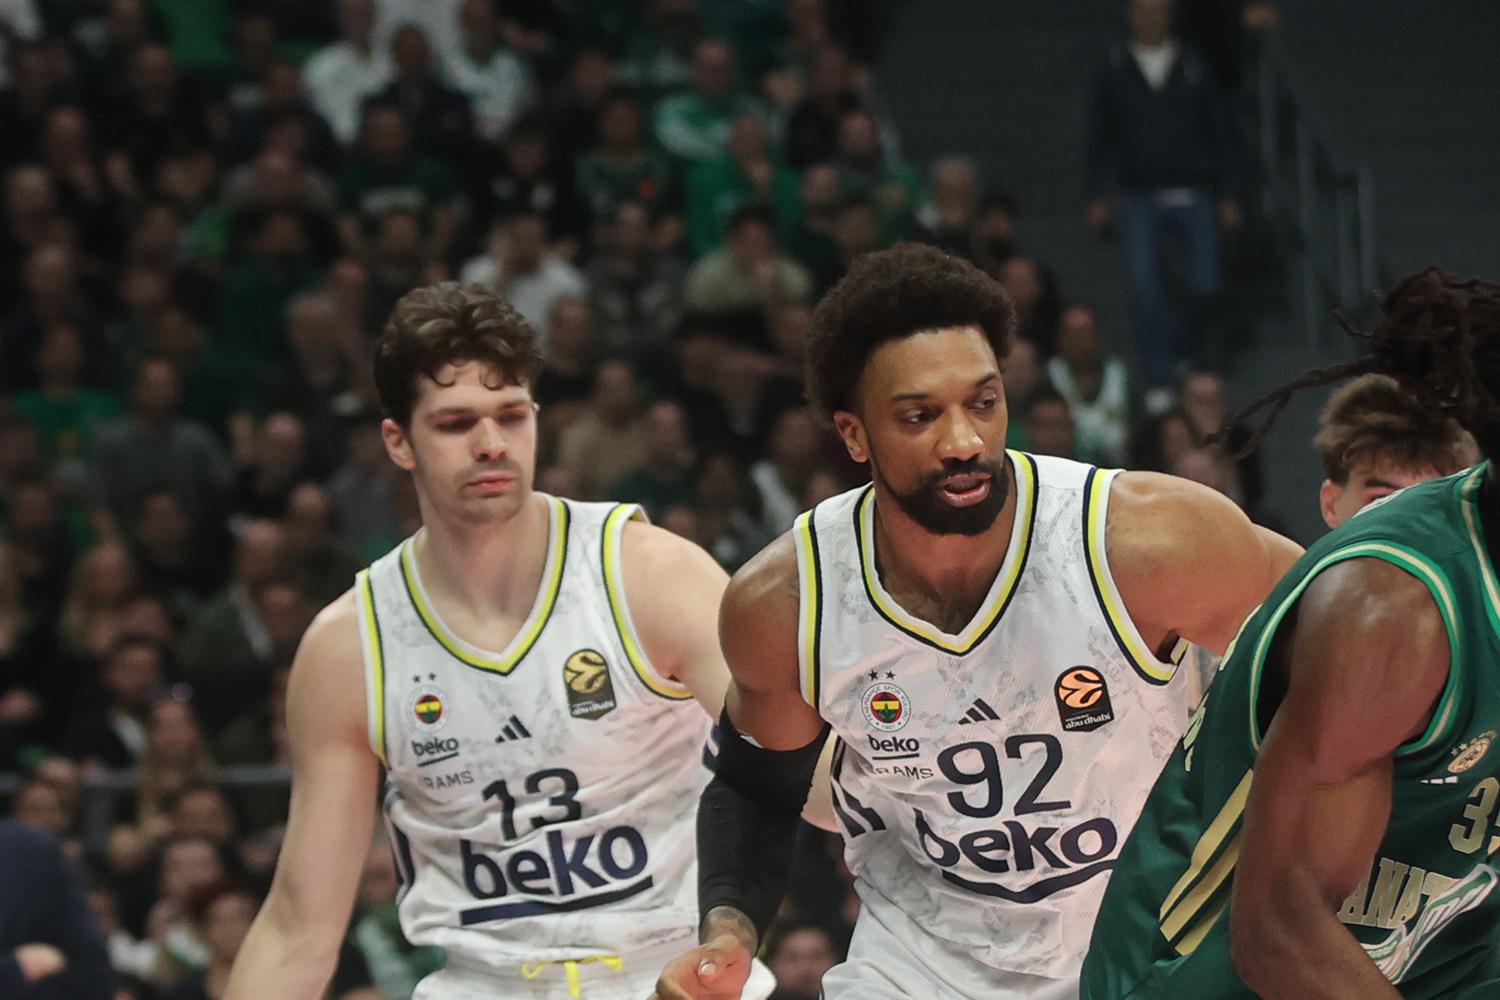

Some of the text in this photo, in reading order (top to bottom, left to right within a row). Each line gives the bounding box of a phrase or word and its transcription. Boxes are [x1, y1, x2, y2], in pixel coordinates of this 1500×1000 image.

[411, 737, 459, 756] beko
[867, 733, 920, 752] beko
[937, 734, 1071, 818] 92
[482, 768, 582, 841] 13
[460, 825, 649, 900] beko
[912, 808, 1118, 873] beko
